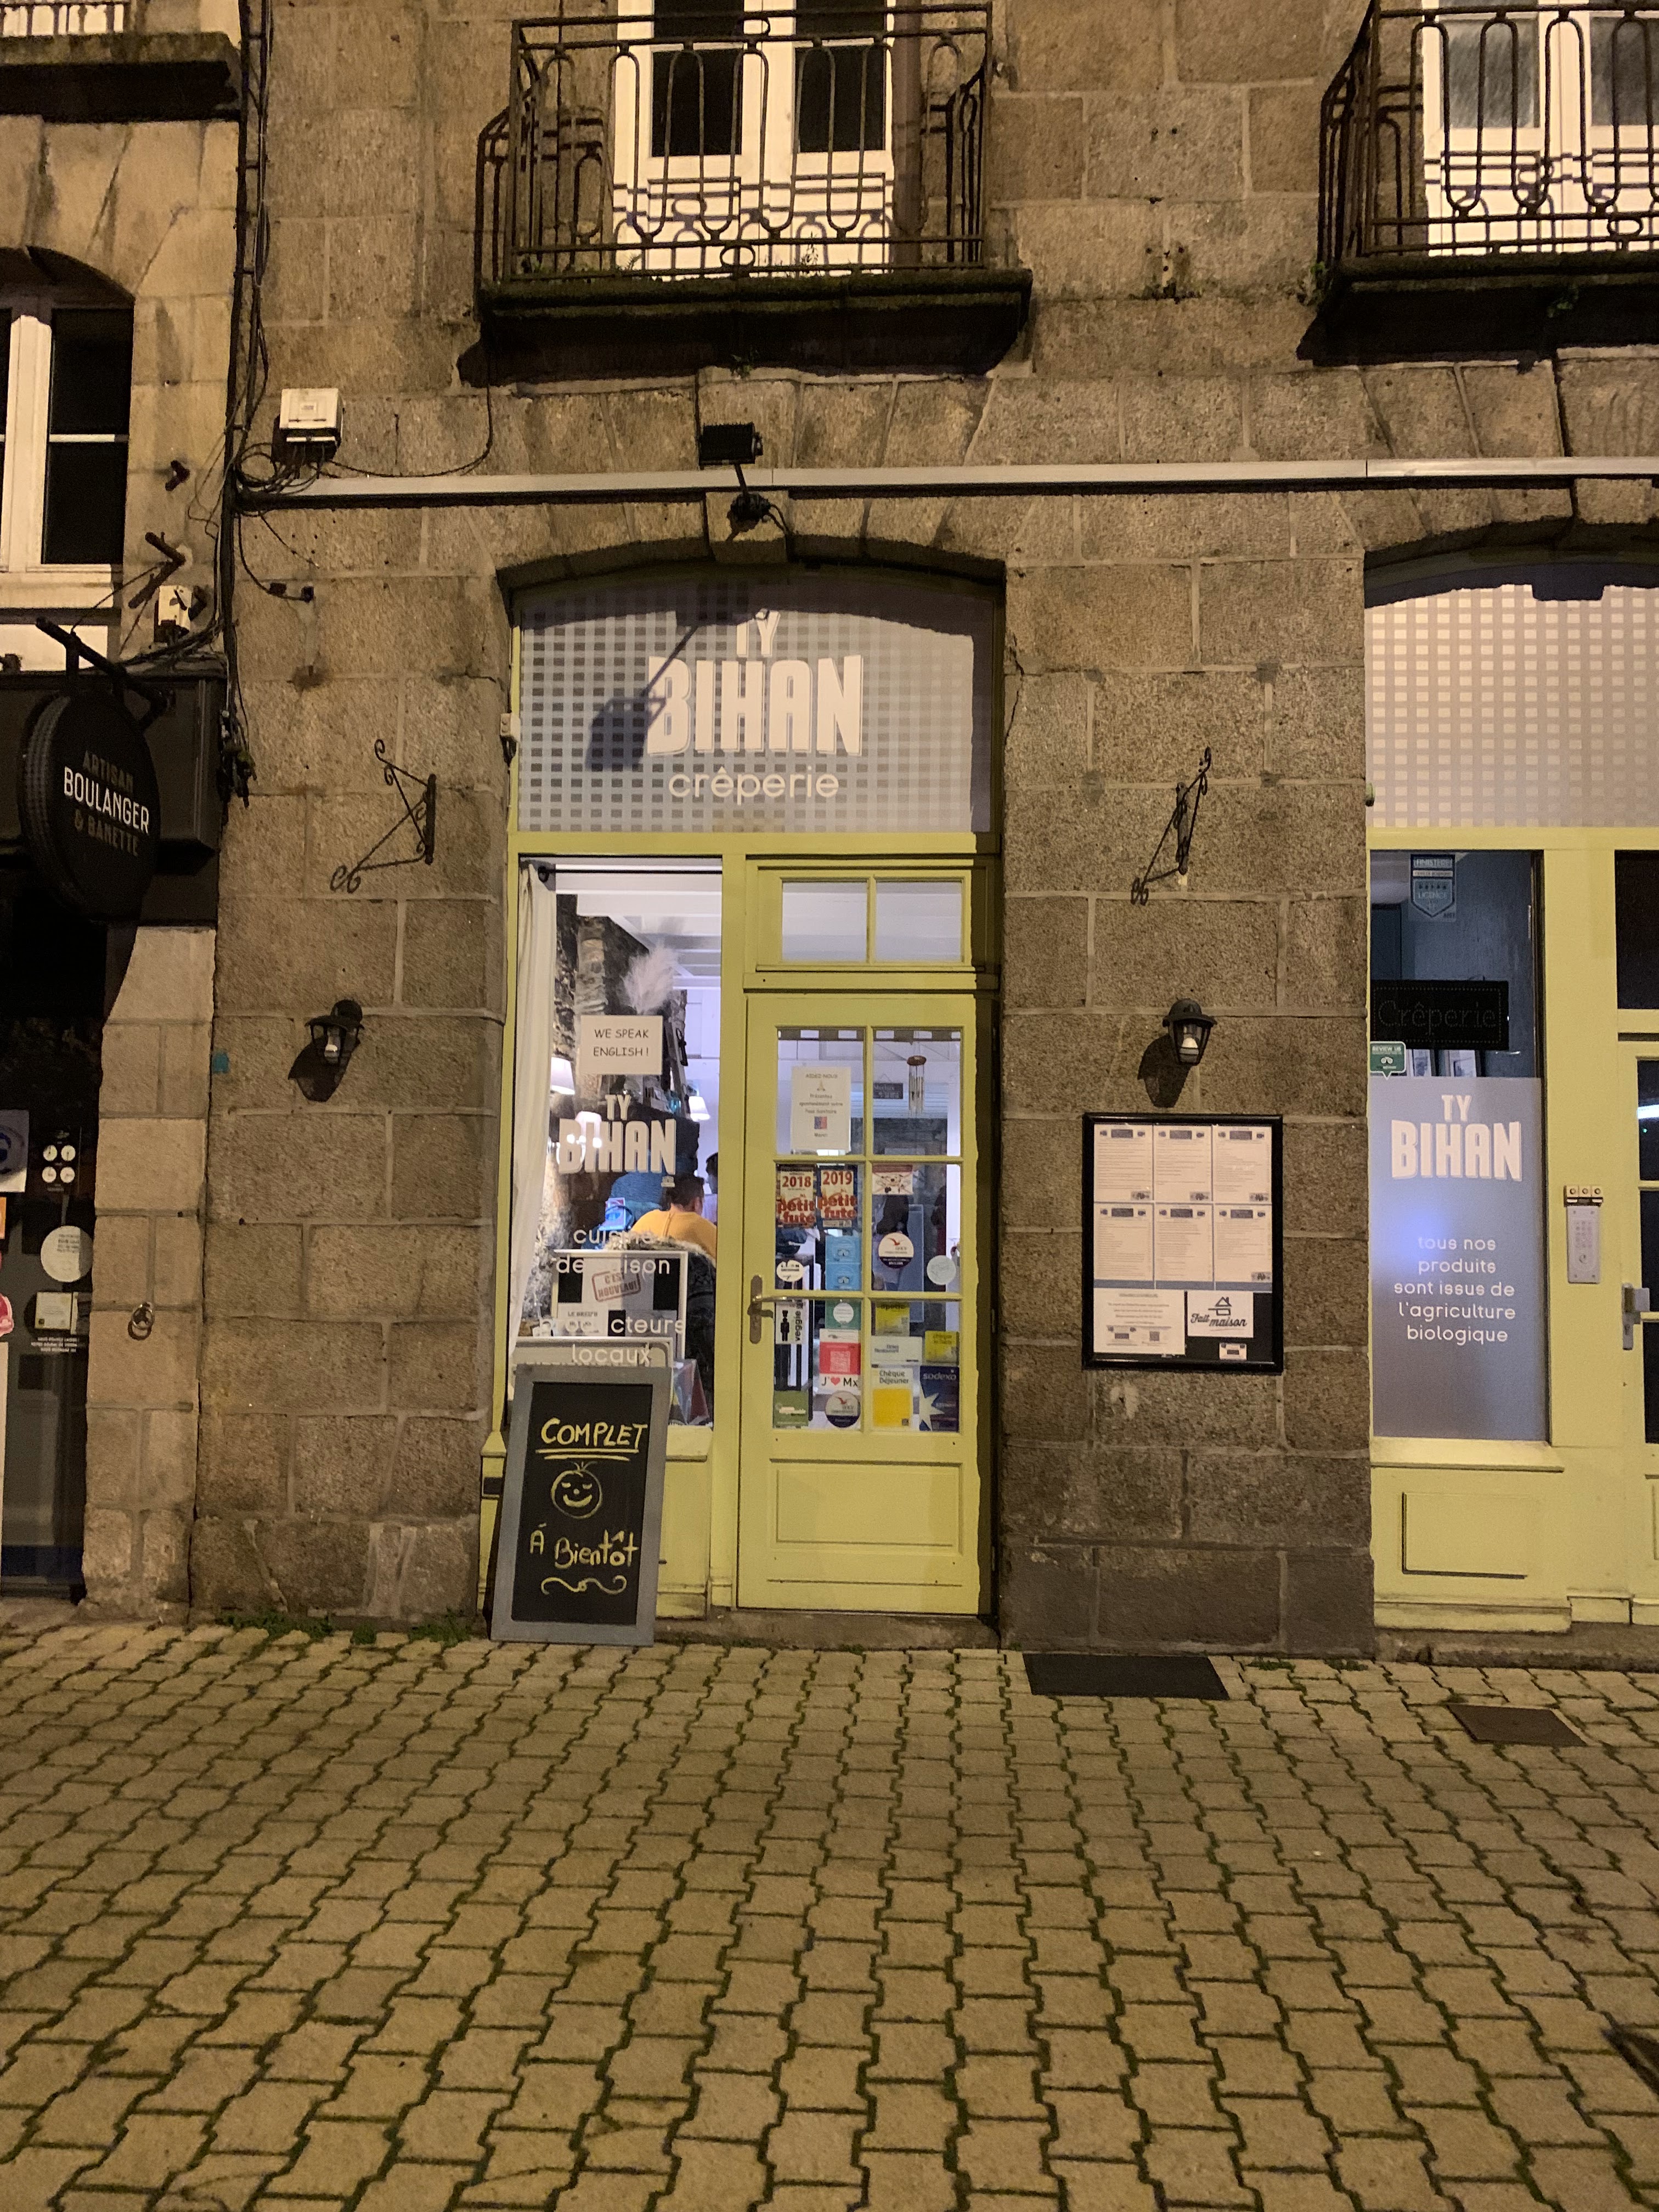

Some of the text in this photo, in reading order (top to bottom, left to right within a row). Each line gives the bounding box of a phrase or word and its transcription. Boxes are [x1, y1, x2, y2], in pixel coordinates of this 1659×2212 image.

[733, 609, 781, 657] TY
[647, 656, 864, 756] BIHAN
[668, 766, 839, 806] crêperie
[64, 766, 150, 836] BOULANGER
[1378, 1000, 1496, 1036] Crêperie
[594, 1029, 649, 1039] WE SPEAK
[605, 1094, 631, 1120] TY
[1441, 1095, 1472, 1121] TY
[558, 1118, 676, 1175] BIHAN
[1391, 1119, 1522, 1182] BIHAN
[782, 1176, 811, 1187] 2018
[822, 1171, 852, 1185] 2019
[777, 1199, 815, 1214] petit
[818, 1194, 856, 1210] petit
[1418, 1237, 1496, 1250] tous nos
[556, 1253, 584, 1274] de
[1418, 1258, 1497, 1275] produits
[1394, 1280, 1515, 1296] sont issus de
[1209, 1317, 1247, 1327] maison
[1399, 1301, 1516, 1322] l'agriculture
[1407, 1324, 1508, 1346] biologique
[572, 1343, 651, 1366] locaux
[923, 1372, 957, 1380] sodexo
[541, 1417, 648, 1450] COMPLET
[554, 1529, 639, 1569] Bientôt
